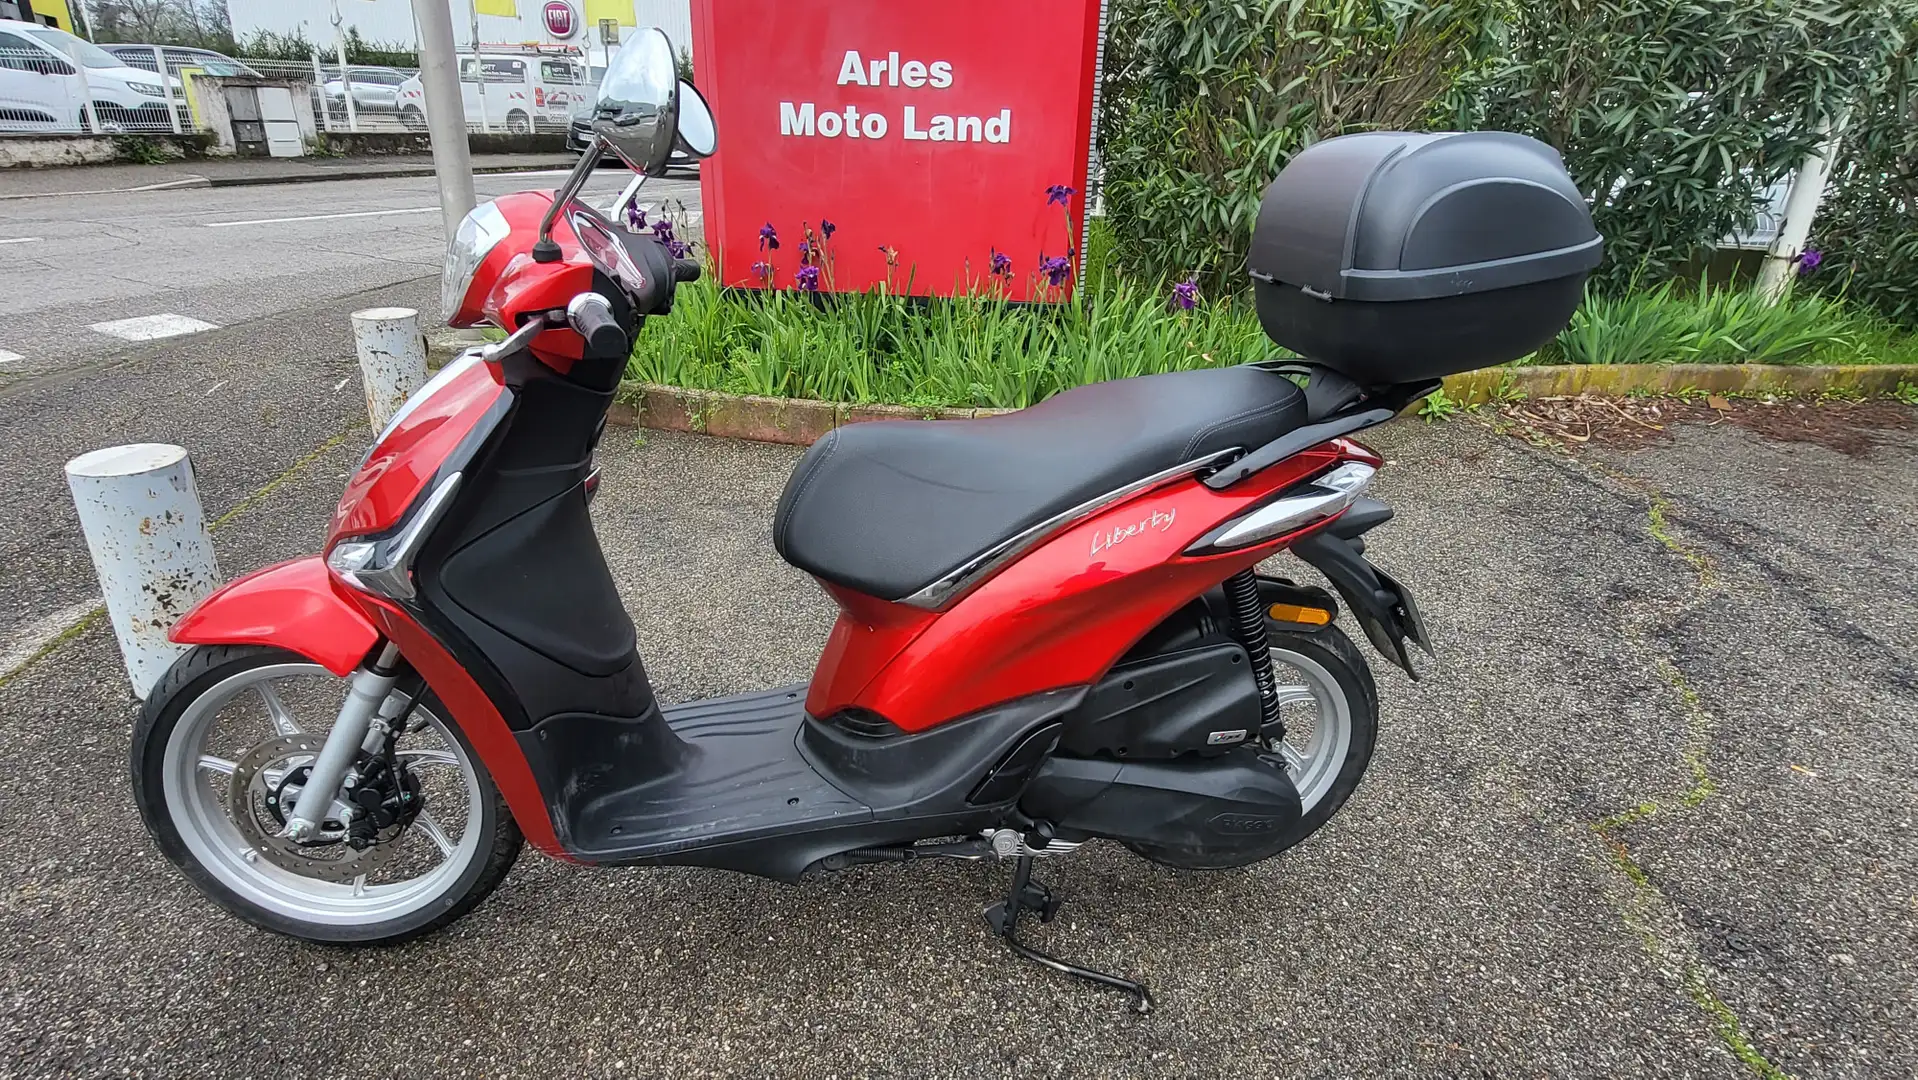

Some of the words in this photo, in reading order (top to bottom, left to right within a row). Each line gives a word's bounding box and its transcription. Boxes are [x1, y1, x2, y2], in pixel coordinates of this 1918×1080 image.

[548, 9, 569, 28] FIAT
[837, 50, 954, 88] Arles
[780, 101, 888, 139] Moto
[903, 105, 1011, 143] Land
[1090, 508, 1176, 557] Liberty
